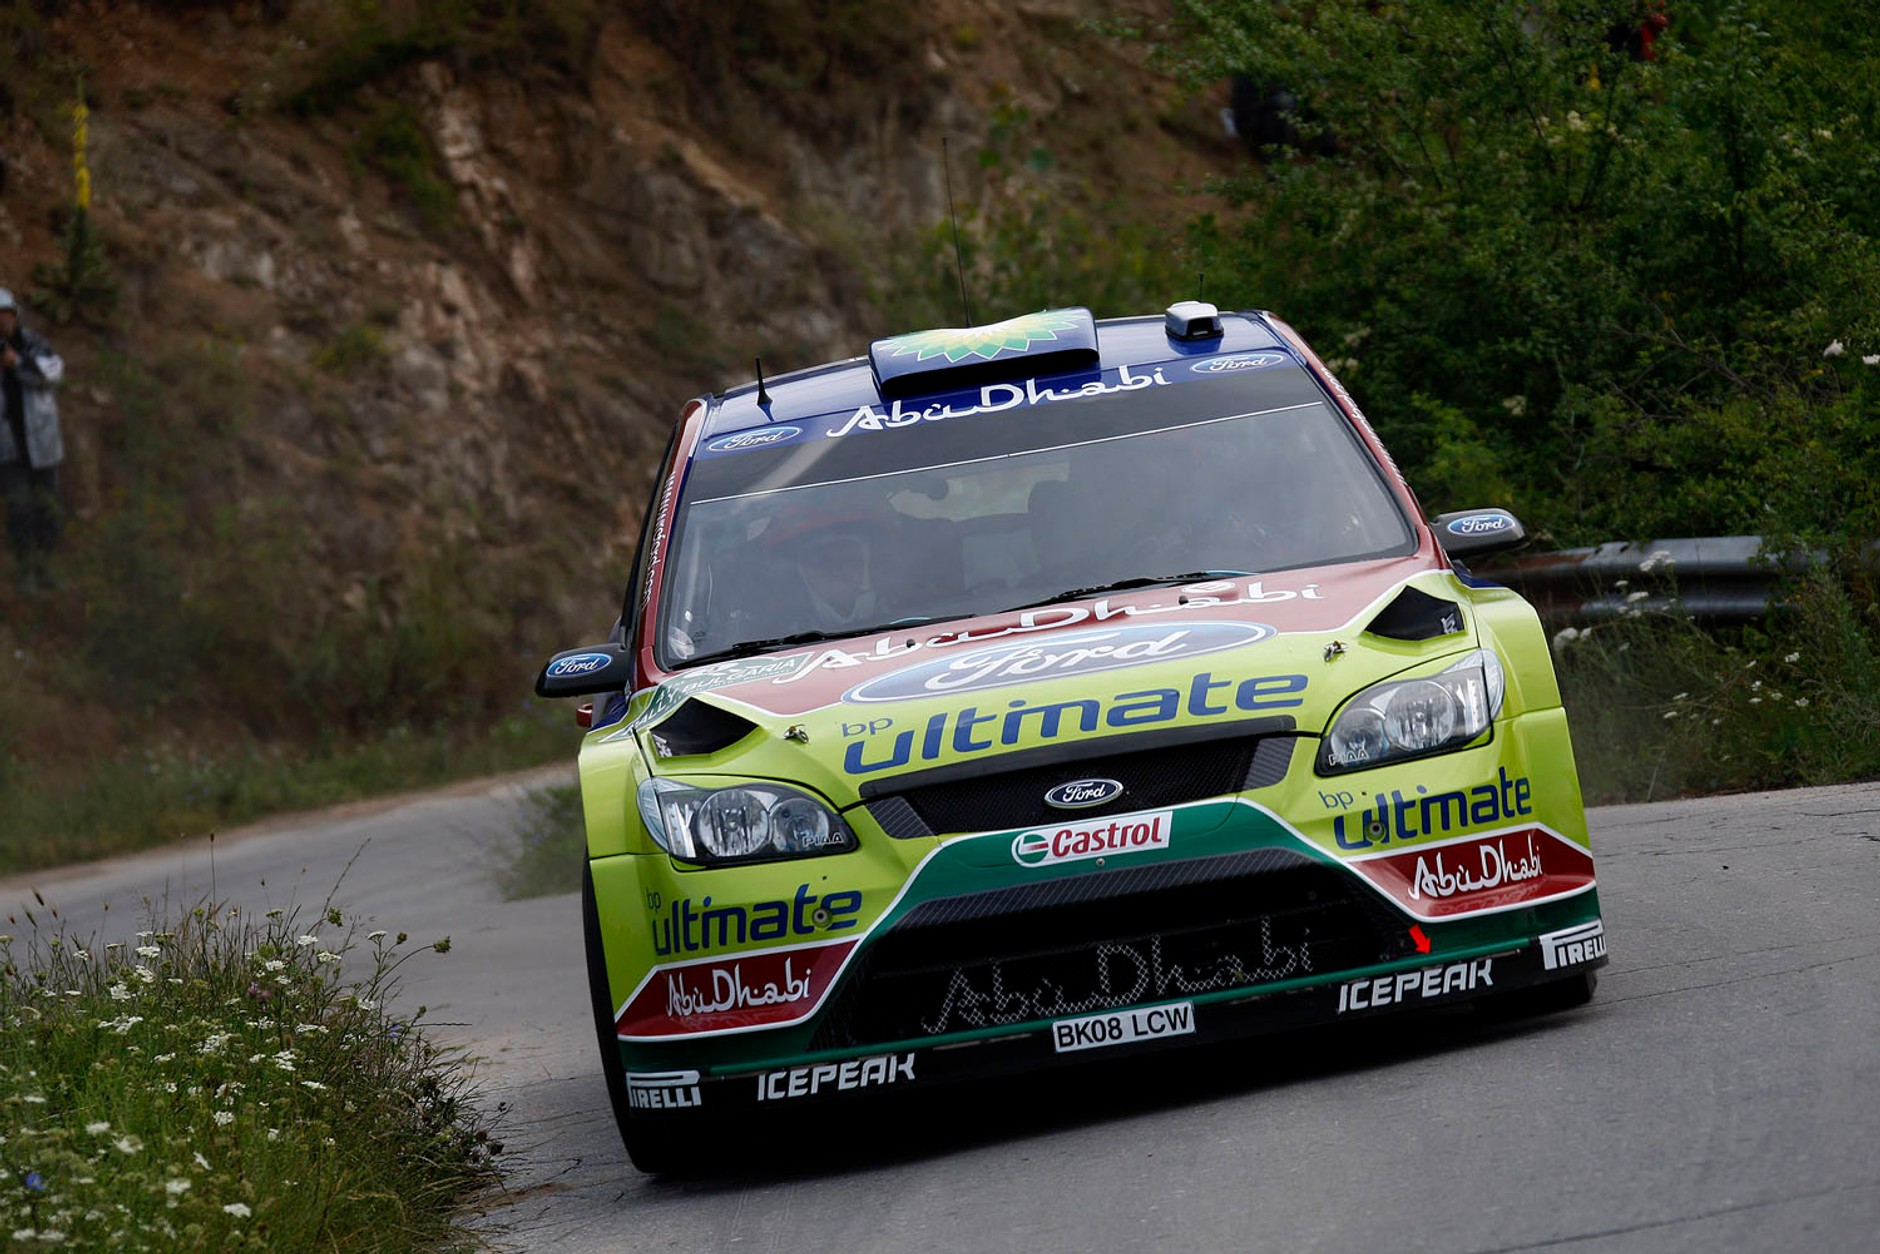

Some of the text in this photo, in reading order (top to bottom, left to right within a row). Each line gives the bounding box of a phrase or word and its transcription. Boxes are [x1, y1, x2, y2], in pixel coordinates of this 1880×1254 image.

[1209, 356, 1267, 371] Ford
[724, 430, 785, 449] Ford
[1461, 516, 1506, 533] Ford
[554, 655, 601, 675] Ford
[924, 629, 1193, 690] Ford
[841, 717, 894, 737] bp
[843, 671, 1309, 774] ultimate
[1062, 782, 1107, 803] Ford
[1318, 790, 1354, 811] bp
[1333, 766, 1533, 851] ultimate
[1051, 816, 1162, 858] Castrol
[645, 886, 661, 912] bp
[652, 883, 863, 957] ultimate
[1336, 958, 1495, 1015] ICEPEAK
[1056, 1006, 1190, 1050] BK08 LCW
[757, 1052, 918, 1102] ICEPEAK
